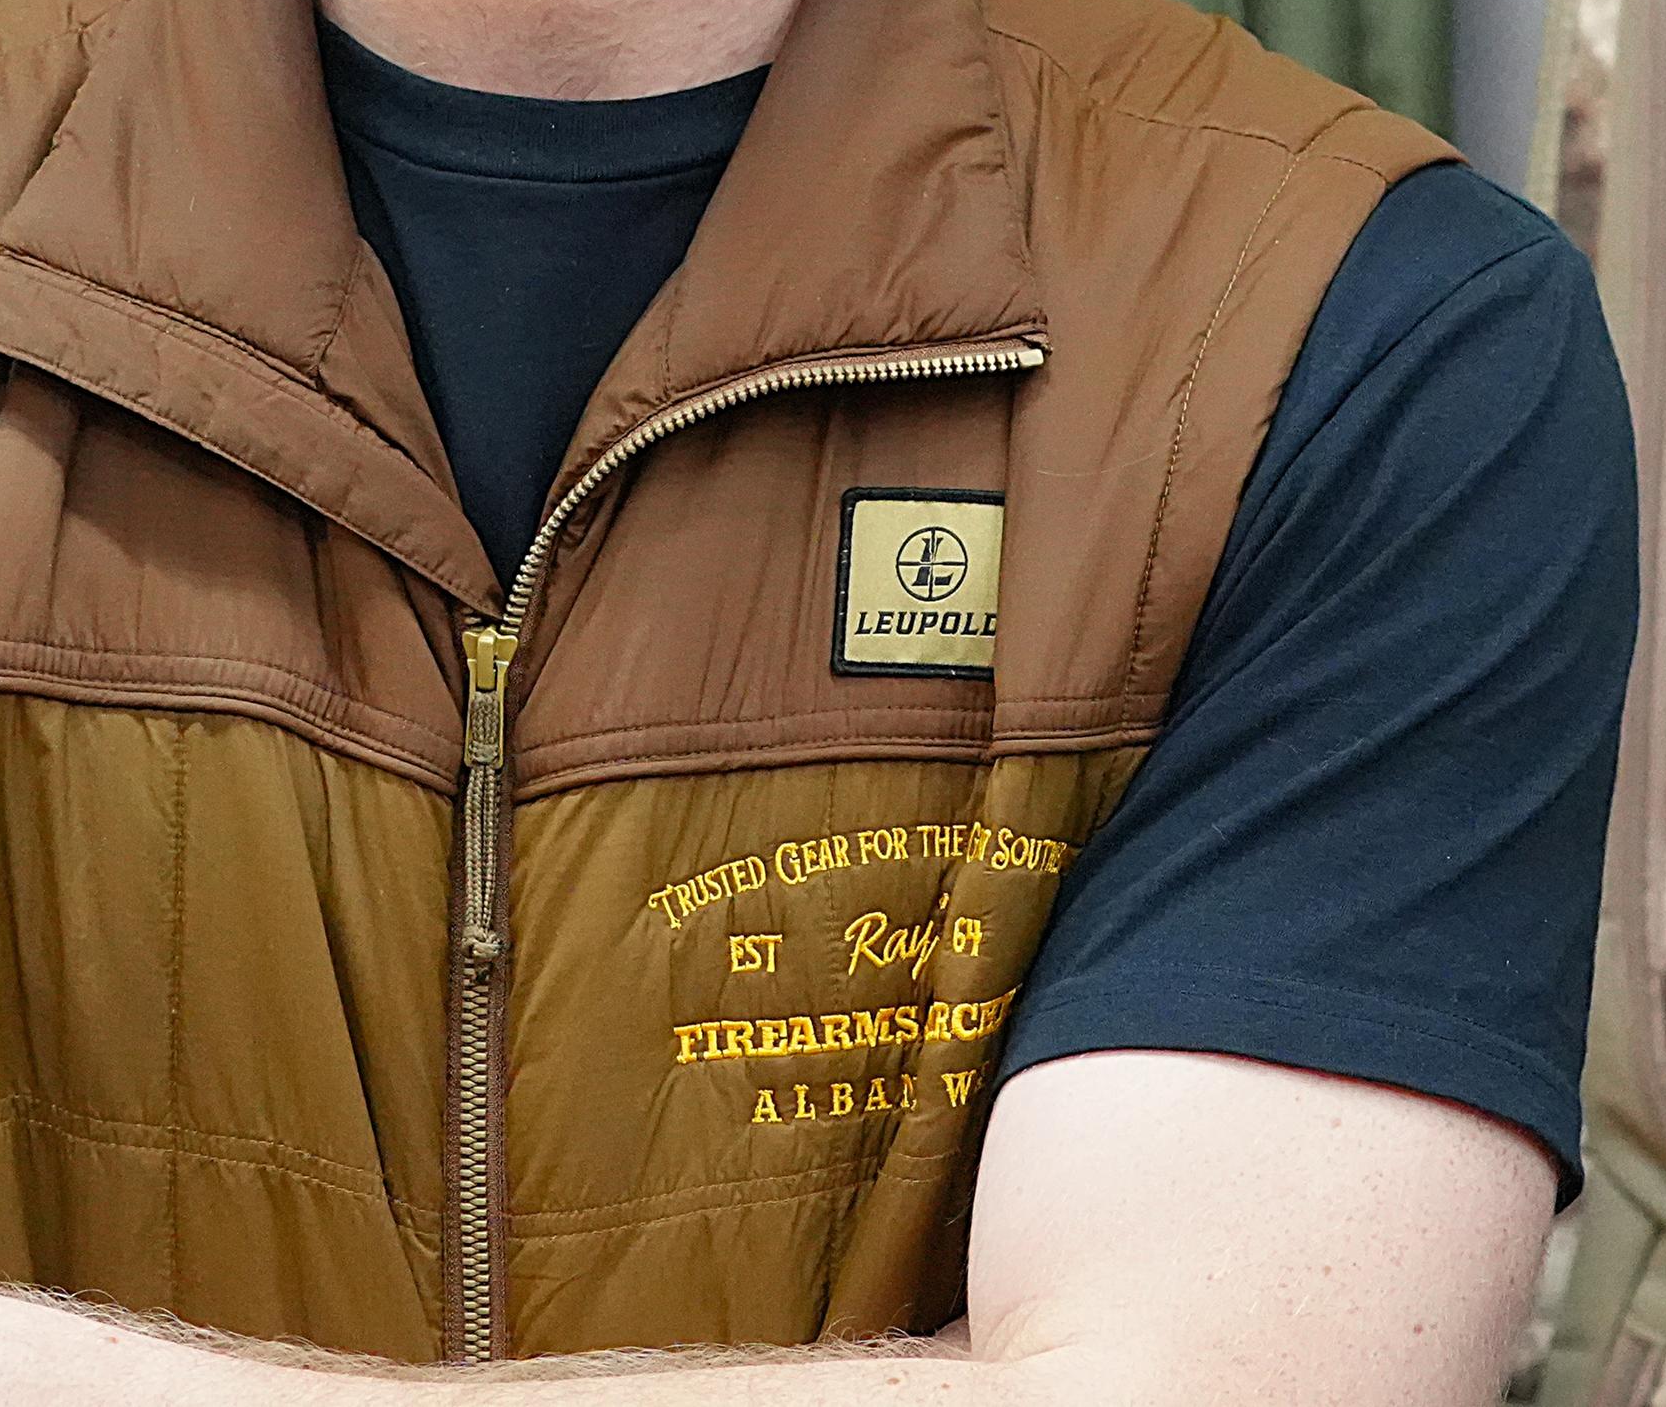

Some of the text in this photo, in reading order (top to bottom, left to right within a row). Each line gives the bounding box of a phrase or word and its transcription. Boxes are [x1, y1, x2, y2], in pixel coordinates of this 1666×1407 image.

[854, 610, 997, 636] LEUPOLD
[648, 855, 767, 930] TRUSTED
[775, 834, 851, 886] GEAR
[857, 826, 909, 865] FOR
[916, 824, 968, 858] THE
[729, 933, 783, 973] EST
[673, 1005, 920, 1064] FIREARMS
